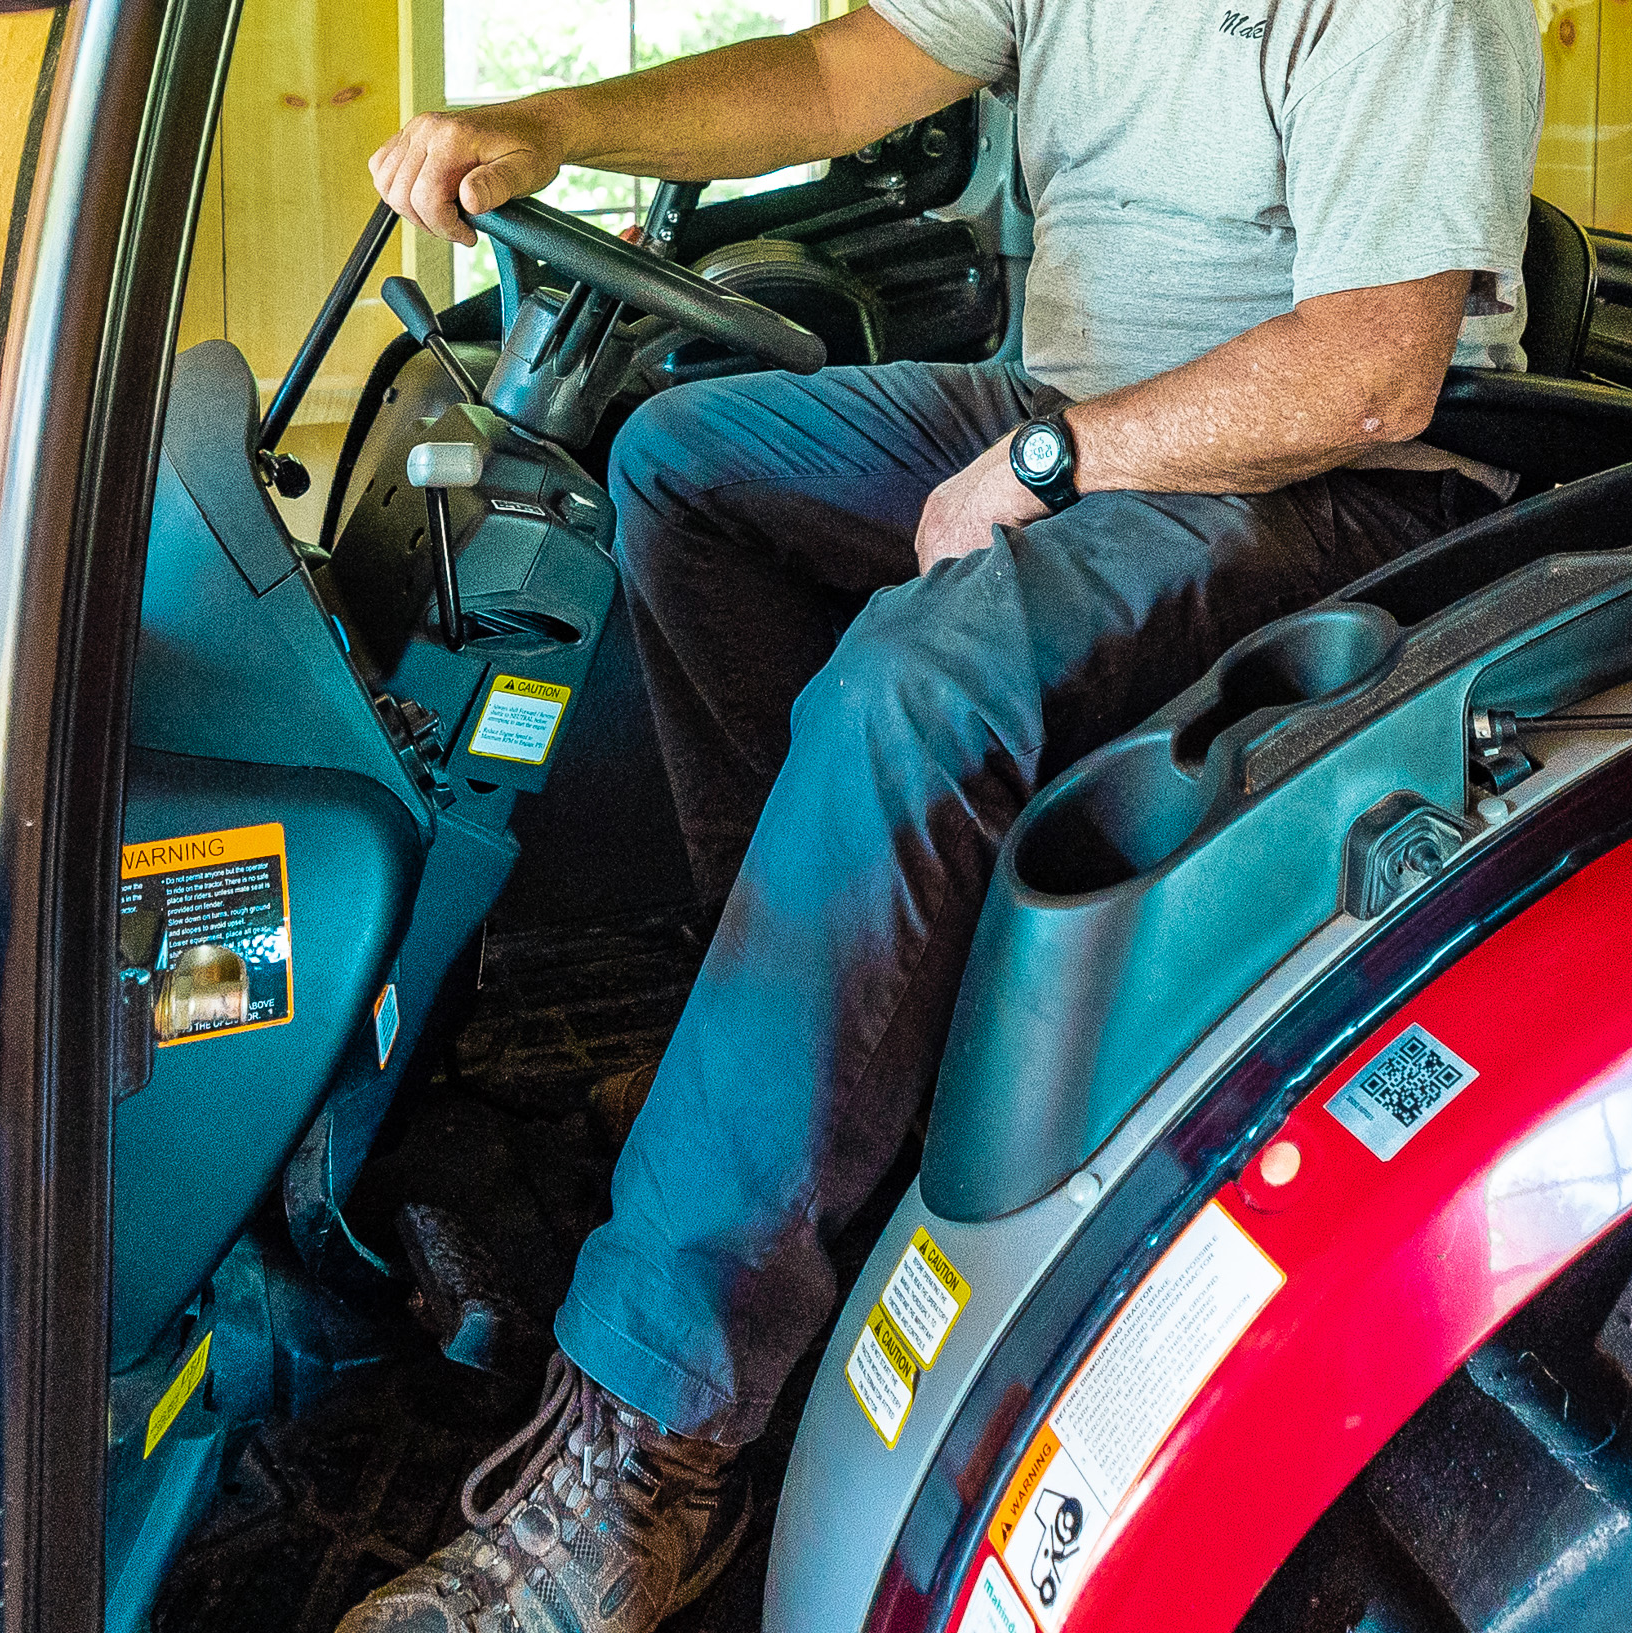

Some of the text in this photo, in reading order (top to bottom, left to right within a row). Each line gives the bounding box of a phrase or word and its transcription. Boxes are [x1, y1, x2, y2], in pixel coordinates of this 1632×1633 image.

[517, 681, 560, 698] CAUTION
[121, 838, 223, 869] WARNING
[927, 1248, 959, 1290] CAUTION
[881, 1329, 911, 1377] CAUTION
[1054, 1386, 1079, 1424] BEFORE
[1079, 1326, 1122, 1386] DISMOUNTING
[1067, 1384, 1093, 1422] ALWAYS
[1093, 1346, 1119, 1384] ENGAGE
[1119, 1306, 1147, 1345] PARKING
[1072, 1404, 1089, 1429] PARK
[1099, 1361, 1119, 1388] LEVEL
[1119, 1322, 1147, 1360] GROUND
[1147, 1274, 1185, 1322] WHENEVER
[1084, 1386, 1113, 1426] PARKING
[1150, 1291, 1183, 1331] POSITION
[1083, 1406, 1109, 1444] ACROSS
[1109, 1388, 1121, 1404] THE
[1088, 1418, 1111, 1453] LOWER
[1123, 1344, 1164, 1400] IMPLEMENTS
[1010, 1443, 1052, 1516] WARNING
